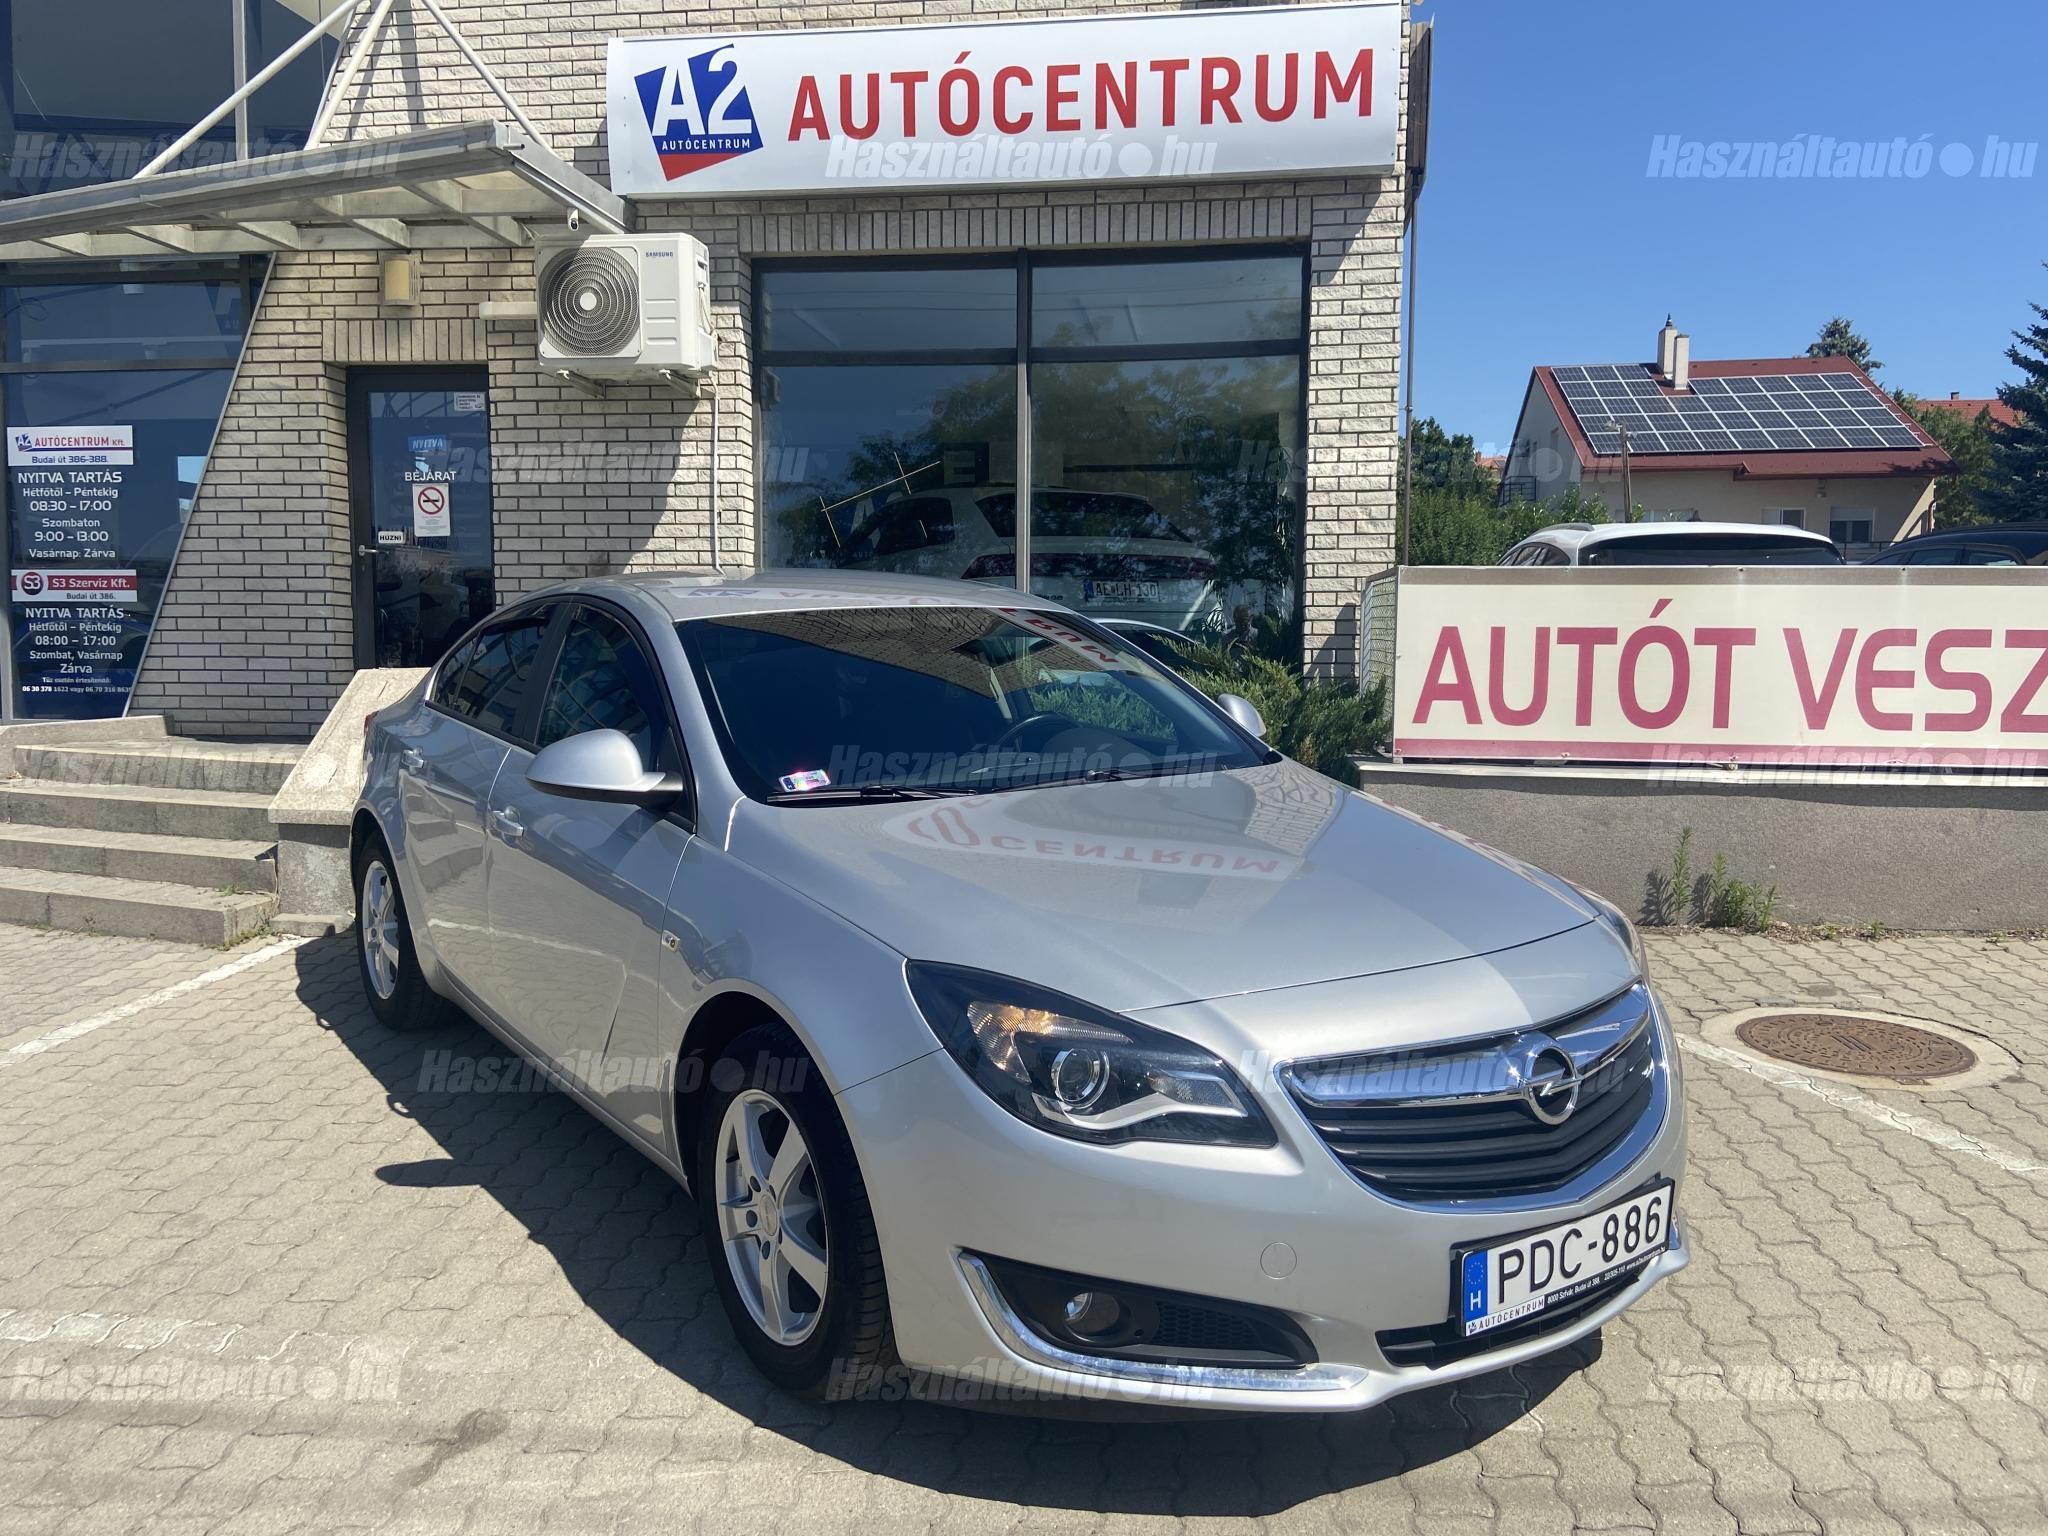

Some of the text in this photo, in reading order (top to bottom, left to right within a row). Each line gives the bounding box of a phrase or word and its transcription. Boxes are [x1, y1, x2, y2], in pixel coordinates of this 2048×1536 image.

[651, 46, 752, 136] A2
[788, 48, 1374, 141] AUTÓCENTRUM
[662, 137, 751, 151] AUTÓCENTRUM
[35, 435, 109, 447] AUTÓCENTRUM
[32, 456, 56, 464] Budai
[58, 455, 66, 463] út
[18, 469, 123, 484] NYITVA TARTÁS
[74, 487, 119, 499] Péntekig
[30, 500, 67, 511] 08:30
[80, 500, 112, 511] 17:00
[42, 518, 101, 528] Szombaton
[35, 531, 65, 541] 9:00
[77, 531, 109, 541] 13:00
[84, 548, 116, 558] Zárva
[23, 575, 41, 590] S3
[52, 578, 130, 588] S3 Szerviz Kft.
[66, 592, 88, 600] Budai
[90, 592, 97, 600] út
[25, 604, 124, 618] NYITVA TARTÁS
[80, 622, 122, 633] Péntekig
[35, 635, 68, 645] 08:00
[83, 634, 117, 646] 17:00
[30, 650, 123, 661] Szombat, Vasárnap
[60, 663, 93, 673] Zárva
[1412, 598, 1757, 730] AUTÓT
[1498, 1196, 1662, 1305] PDC-886
[1470, 1290, 1481, 1311] H
